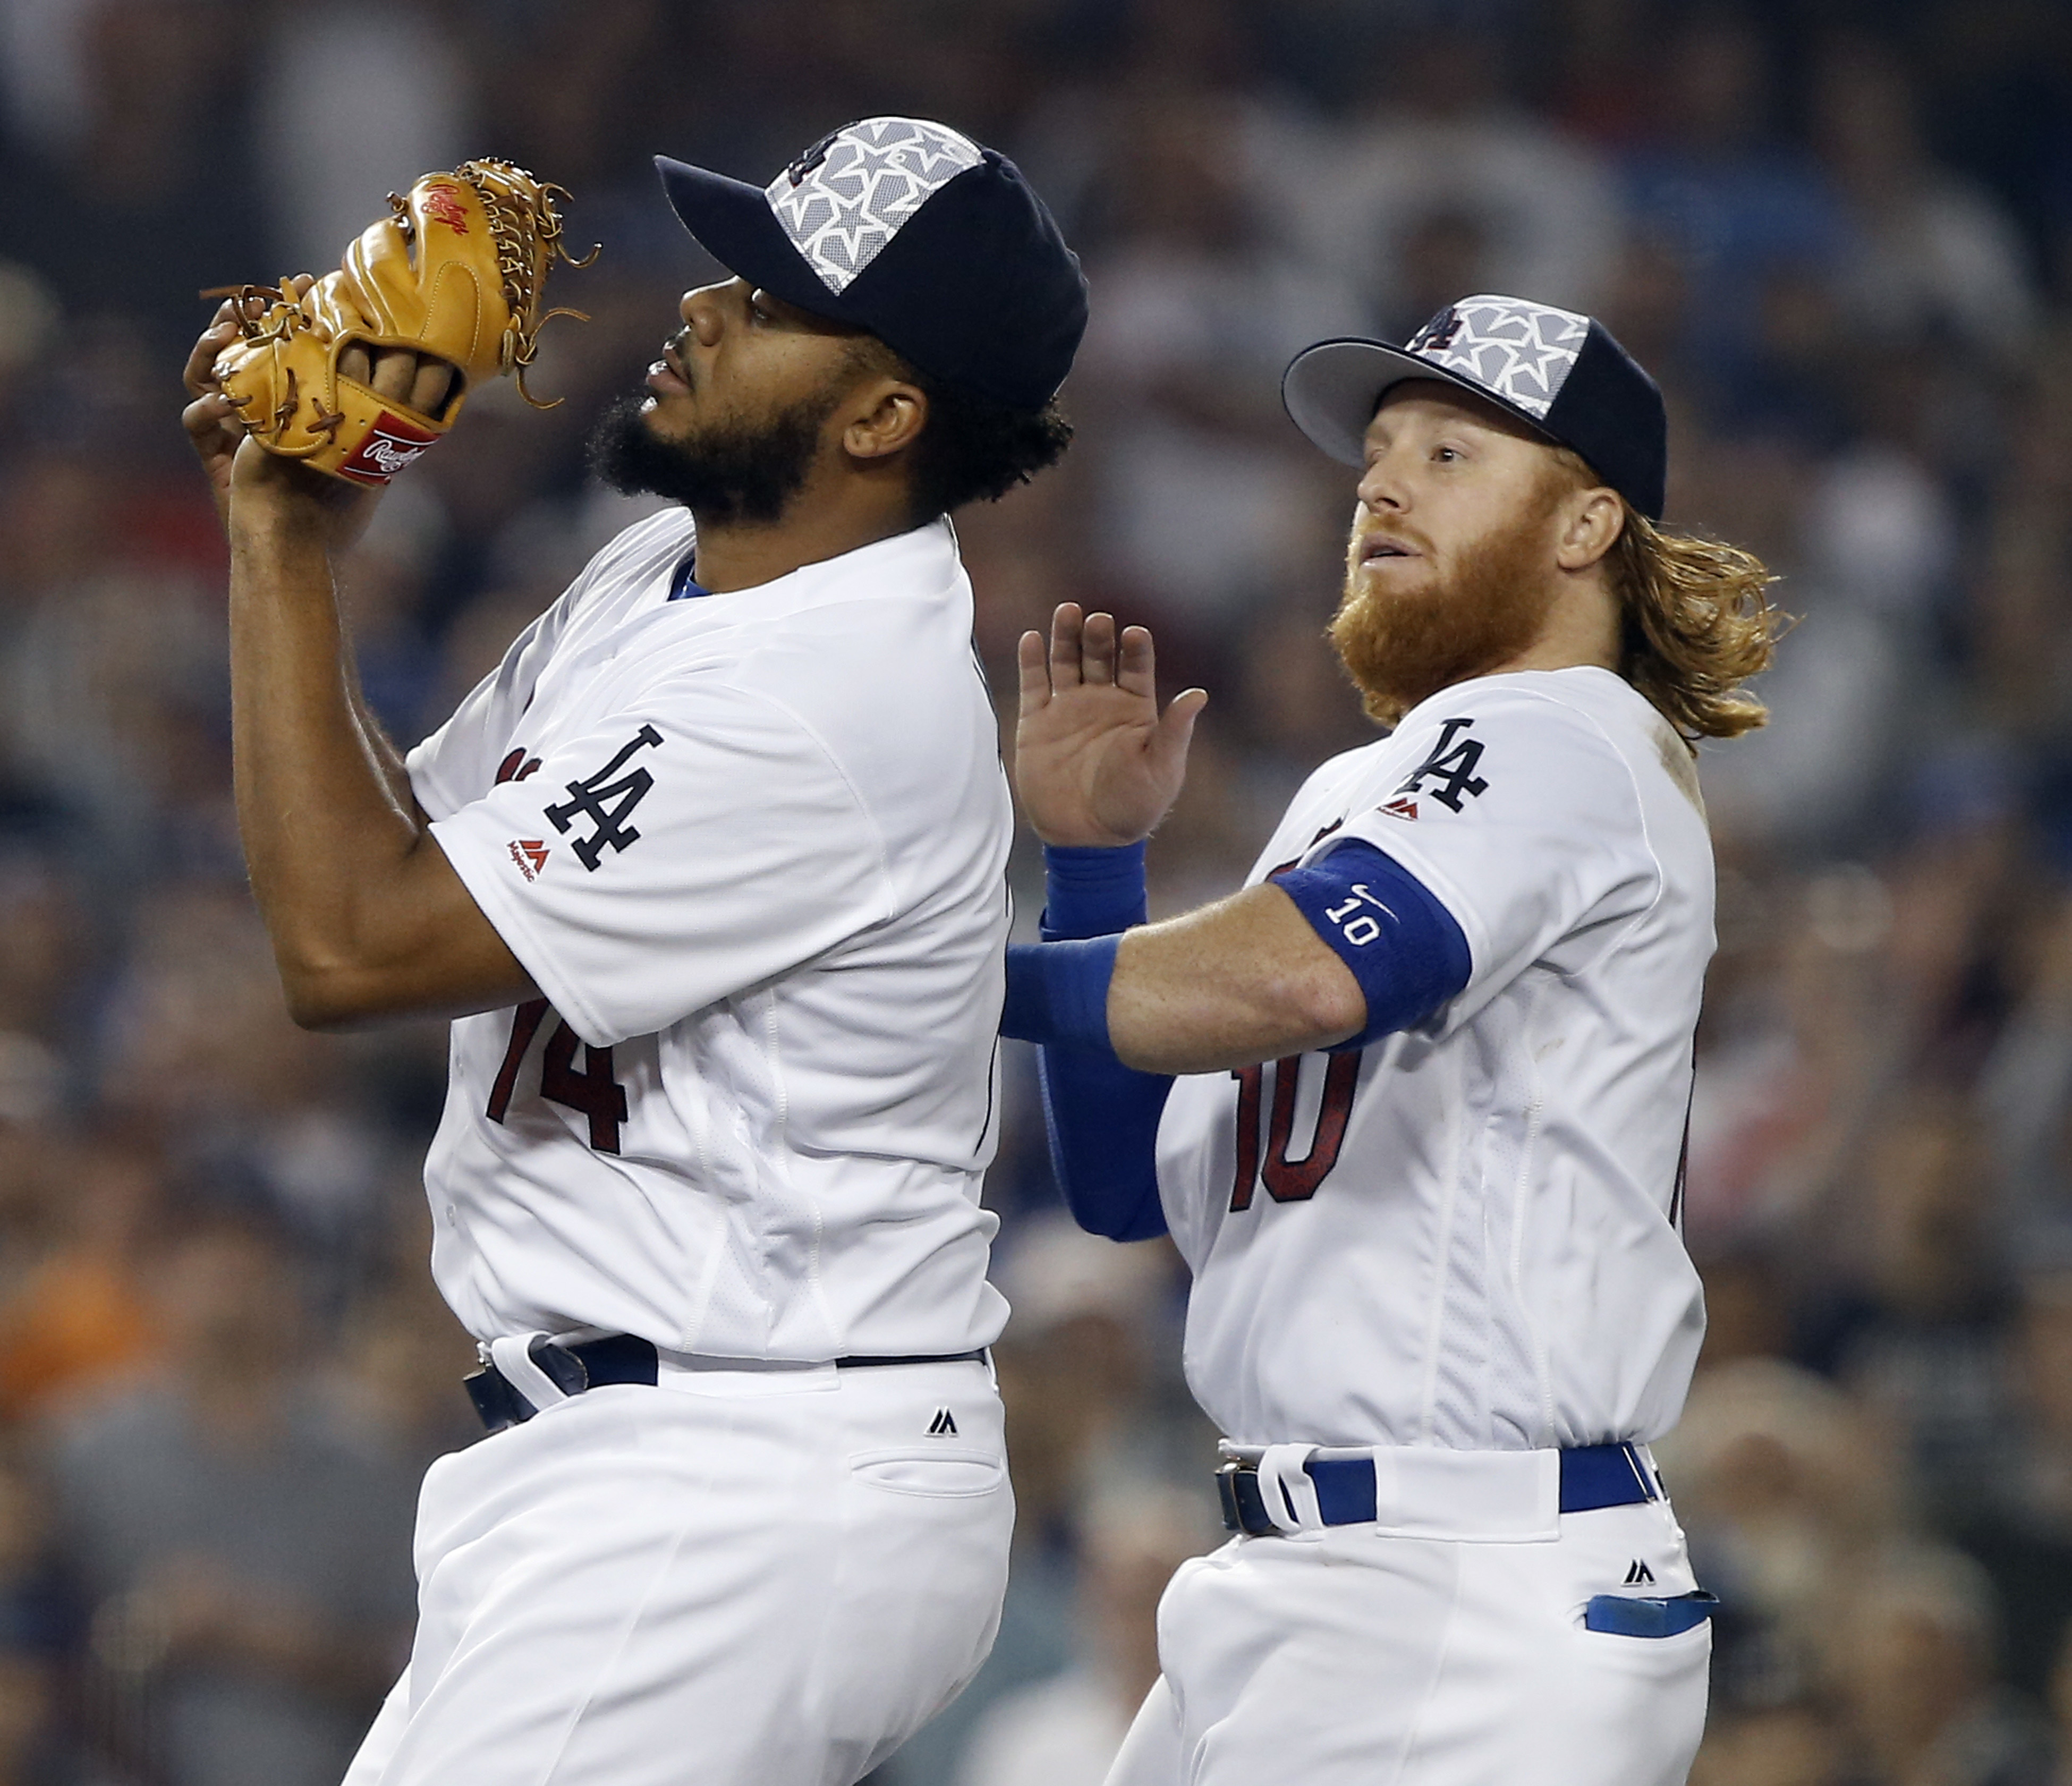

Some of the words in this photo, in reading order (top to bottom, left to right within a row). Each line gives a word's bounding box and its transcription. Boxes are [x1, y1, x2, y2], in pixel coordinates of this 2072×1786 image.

[544, 724, 664, 872] LA
[1393, 718, 1490, 813] LA
[507, 840, 534, 882] Majestic
[1325, 898, 1381, 946] 10
[1229, 1049, 1363, 1213] 10
